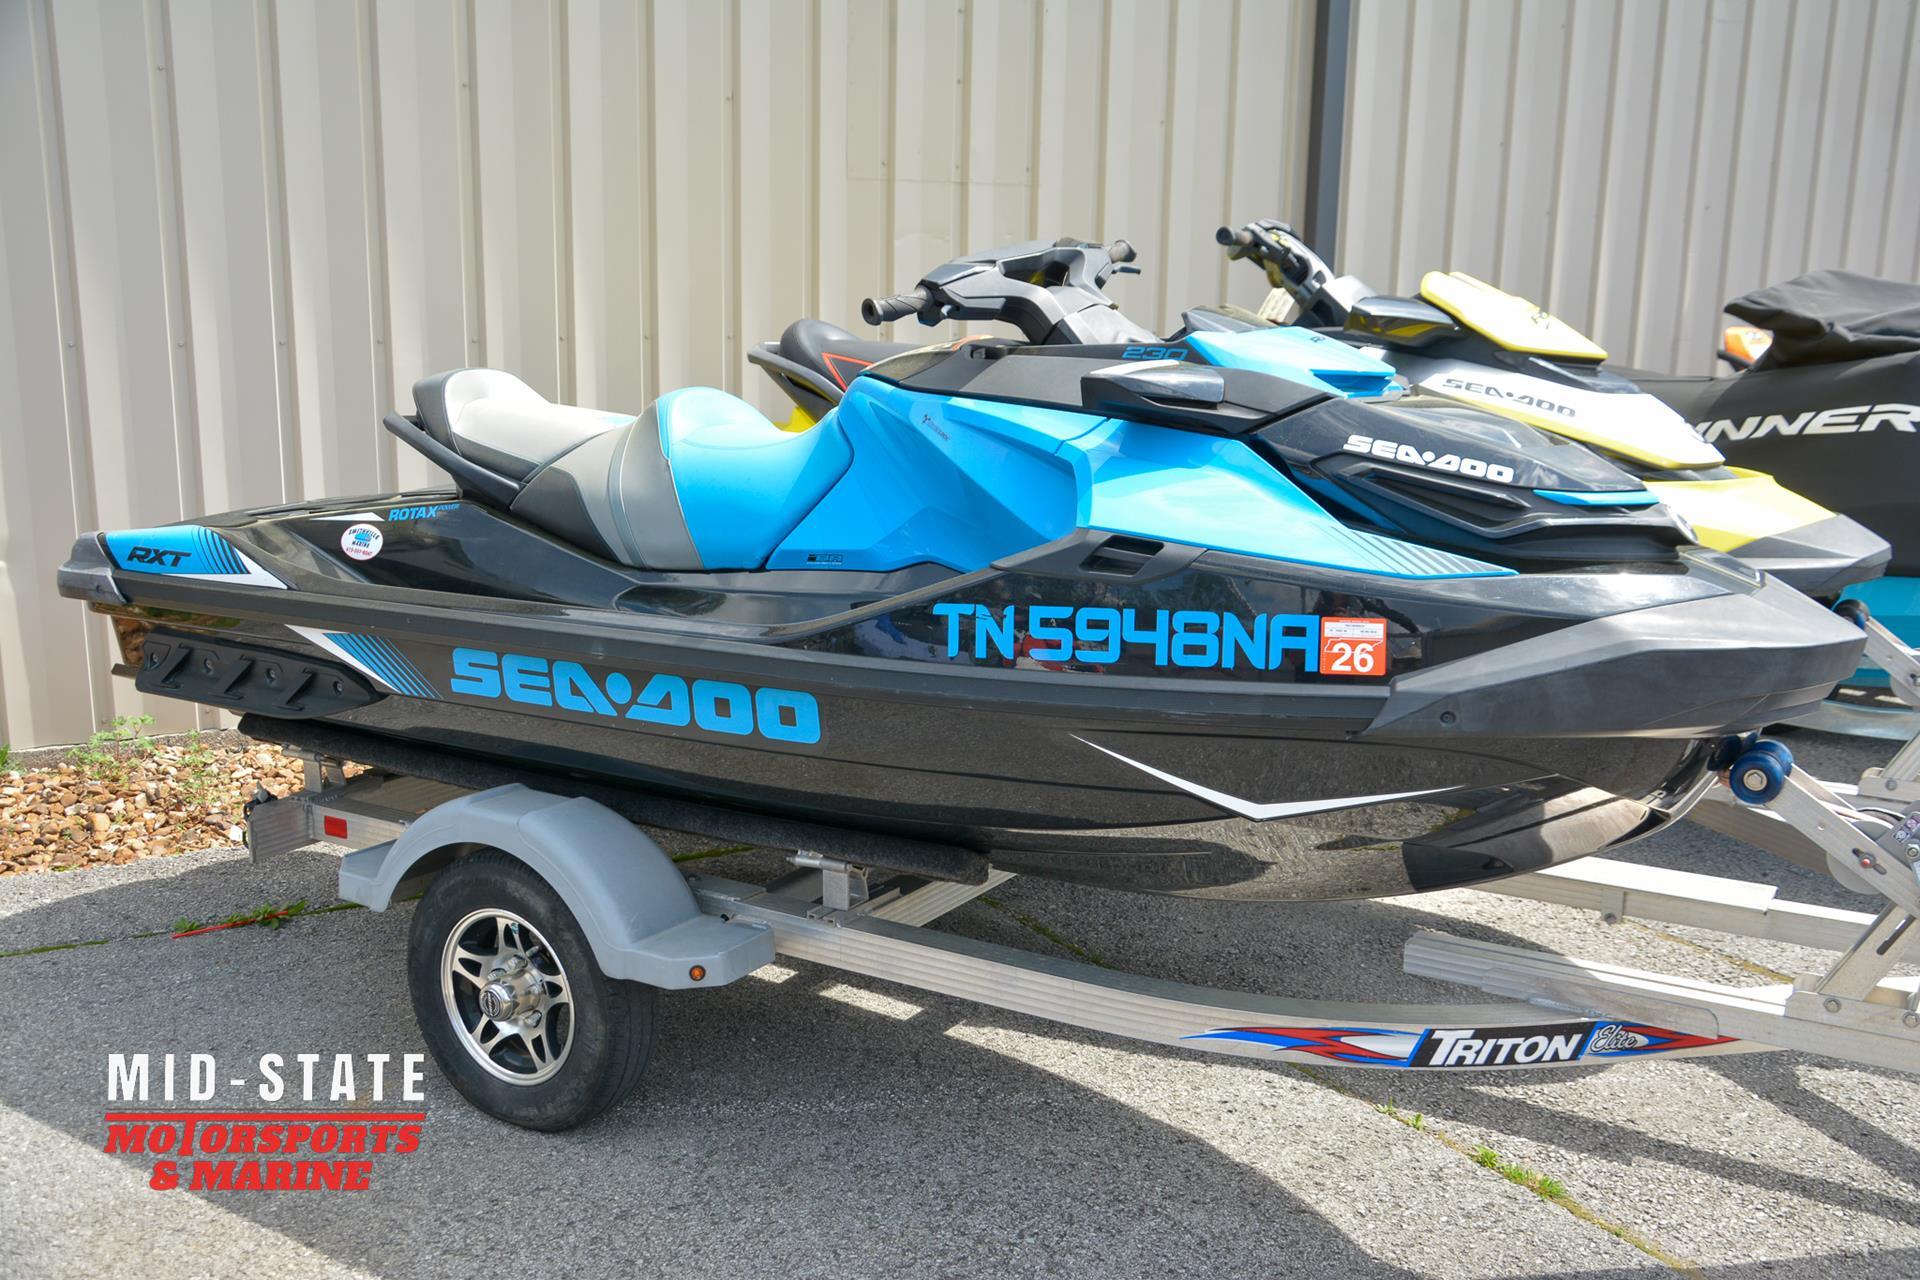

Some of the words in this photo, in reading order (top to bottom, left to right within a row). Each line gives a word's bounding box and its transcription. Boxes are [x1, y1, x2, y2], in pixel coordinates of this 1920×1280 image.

[1121, 346, 1189, 361] 230
[388, 505, 439, 522] ROTAX
[127, 546, 193, 568] RXT
[932, 603, 1015, 660] TN
[1331, 642, 1374, 673] 26
[1428, 1029, 1583, 1067] TRITON
[1590, 1024, 1638, 1052] Elite
